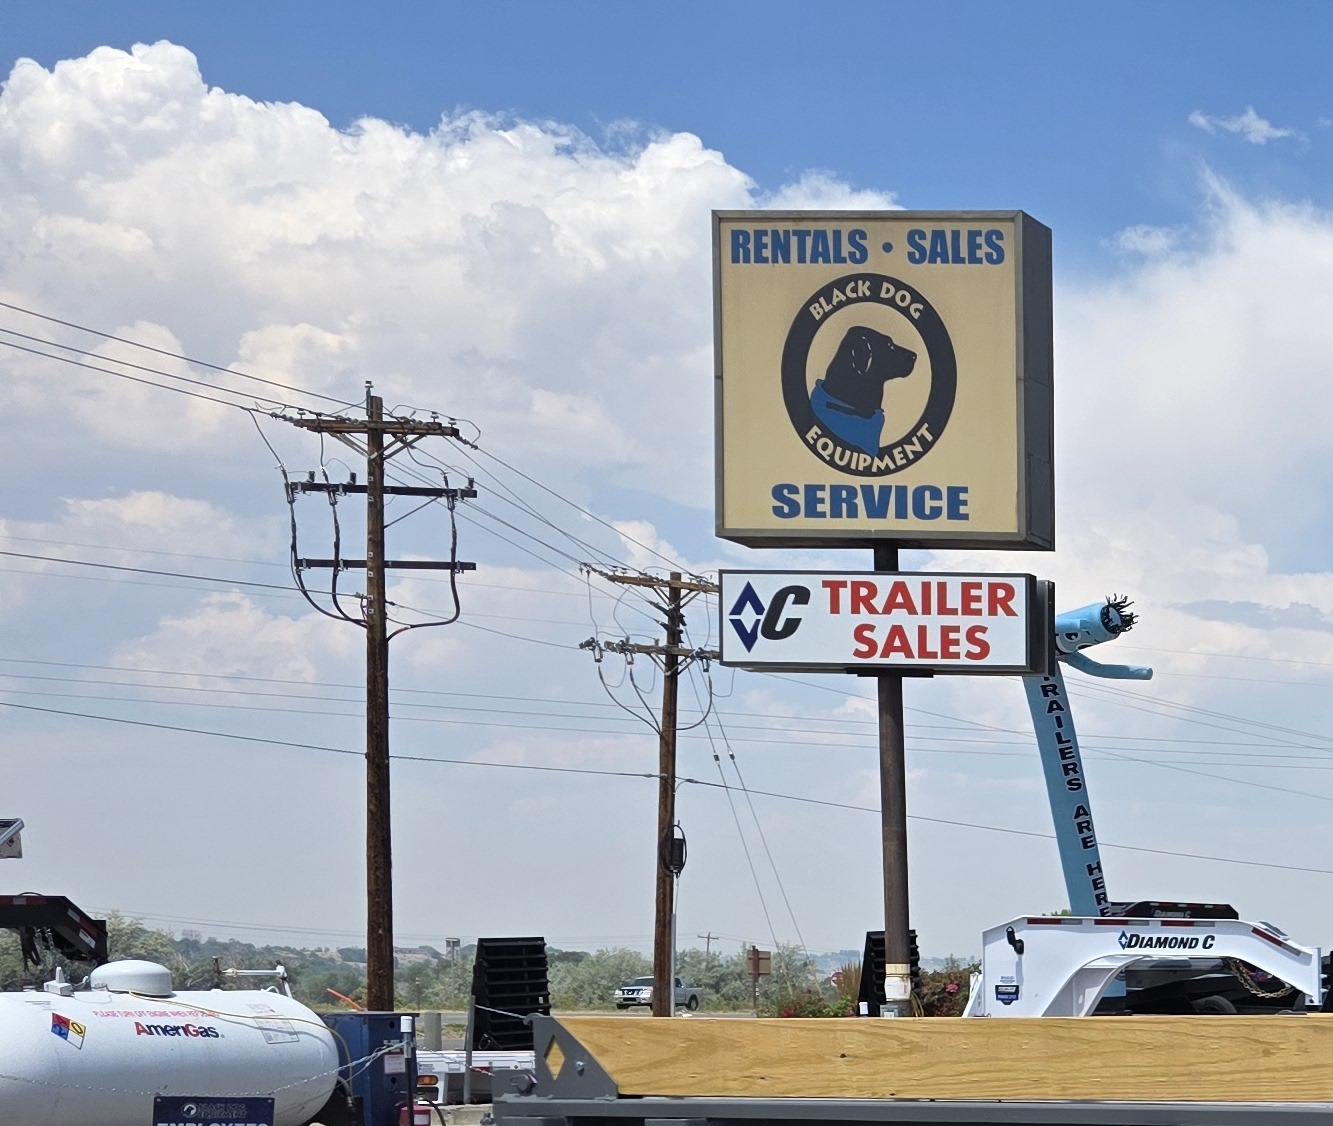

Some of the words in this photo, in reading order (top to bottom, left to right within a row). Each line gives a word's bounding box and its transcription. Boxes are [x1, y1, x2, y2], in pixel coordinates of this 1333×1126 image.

[731, 228, 868, 264] RENTALS
[906, 229, 1006, 265] SALES
[809, 280, 871, 321] BLACK
[879, 280, 924, 320] DOG
[805, 423, 934, 473] EQUIPMENT
[771, 483, 969, 520] SERVICE
[822, 580, 1018, 617] TRAILER
[852, 623, 991, 660] SALES
[1073, 804, 1096, 850] ARE
[1086, 861, 1111, 917] HERE
[1126, 933, 1199, 949] DIAMOND
[1202, 935, 1215, 949] C
[71, 1022, 83, 1034] 0
[134, 1021, 219, 1038] AmeriGas
